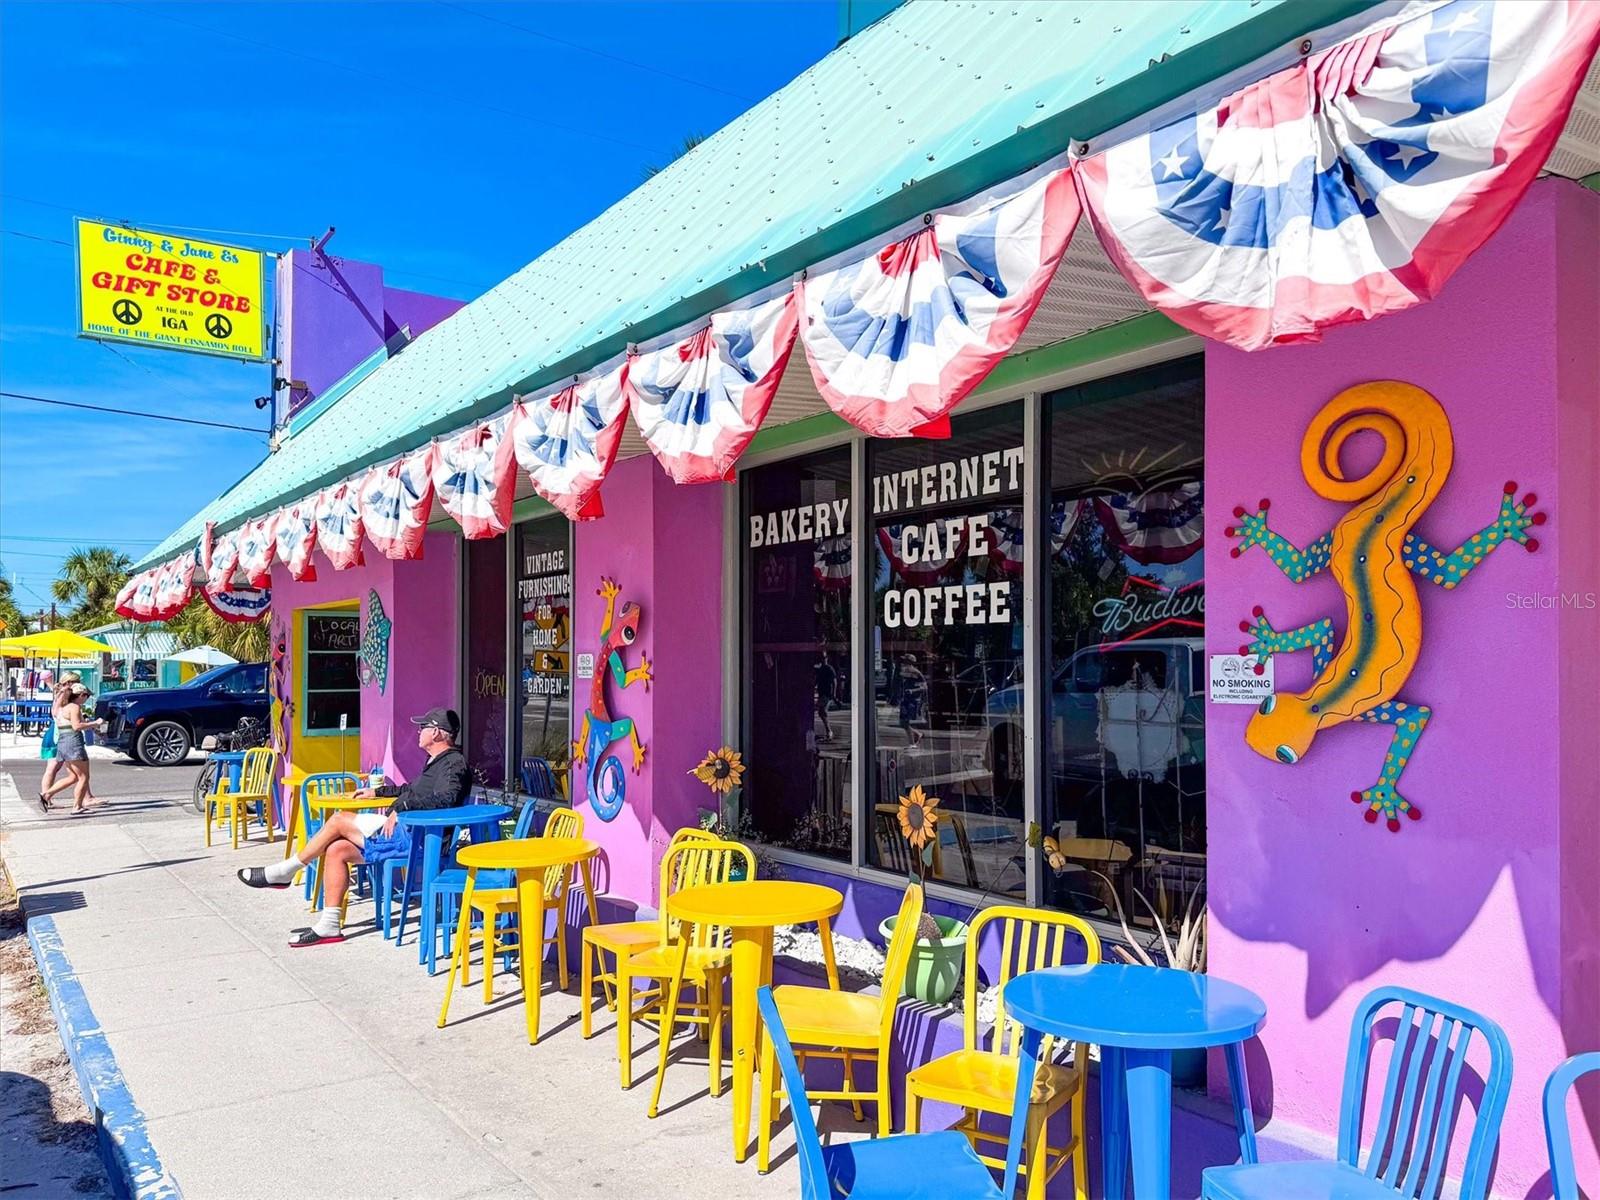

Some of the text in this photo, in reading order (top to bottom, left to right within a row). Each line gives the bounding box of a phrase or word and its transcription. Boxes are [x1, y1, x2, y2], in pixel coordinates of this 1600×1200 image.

[103, 227, 239, 264] Ginny & Jane Es
[125, 253, 221, 285] CAFE &
[92, 271, 250, 313] GIFT STORE
[161, 316, 188, 331] IGA
[88, 322, 253, 354] HOME OF THE GIANT CINNAMON ROLL
[873, 445, 1024, 514] INTERNET
[750, 498, 849, 548] BAKERY
[901, 515, 989, 565] CAFE
[526, 549, 564, 575] VINTAGE
[538, 604, 552, 620] FOR
[883, 581, 1010, 628] COFFEE
[320, 620, 360, 634] LOCAL
[533, 628, 558, 646] HOME
[328, 633, 356, 649] ART
[542, 652, 548, 669] &
[475, 670, 505, 698] OPEN
[527, 677, 562, 694] GARDEN
[1212, 679, 1271, 688] NO SMOKING
